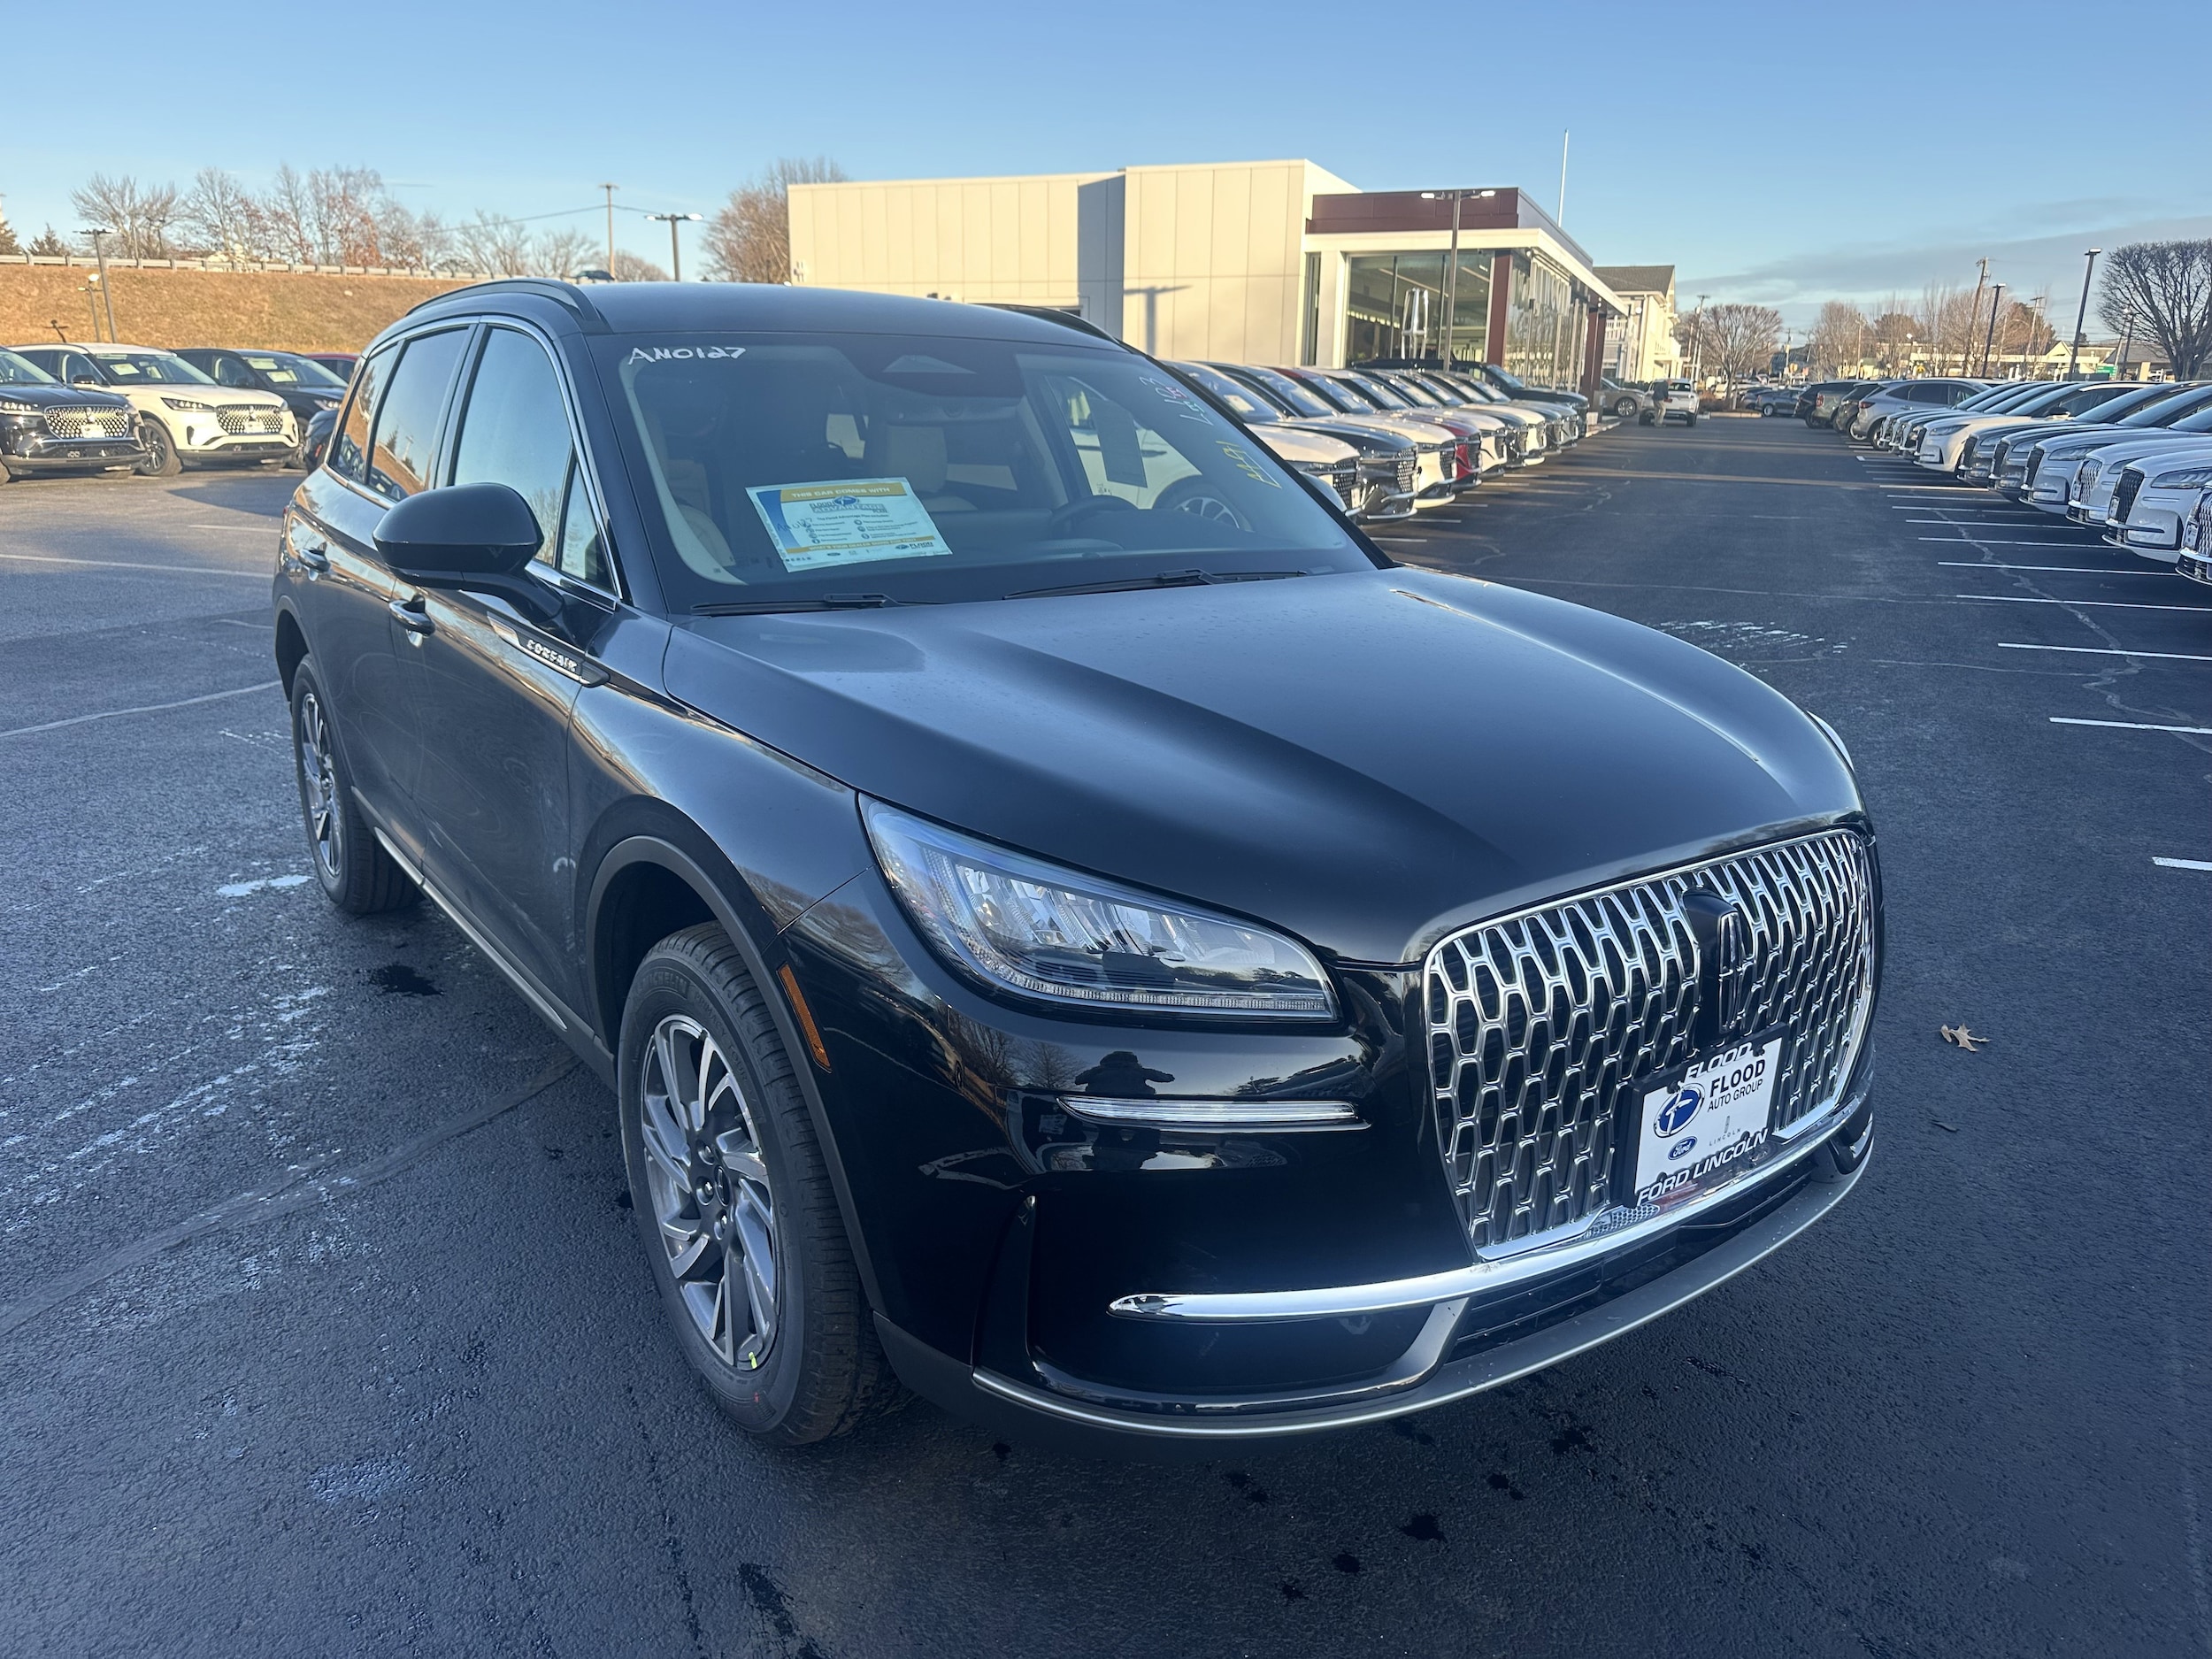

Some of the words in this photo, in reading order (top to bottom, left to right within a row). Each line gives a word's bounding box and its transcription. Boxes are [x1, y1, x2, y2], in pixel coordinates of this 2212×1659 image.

[813, 503, 885, 513] ADVANTAGE
[526, 639, 578, 672] CORSAIR
[1685, 1042, 1753, 1079] FLOOD
[1709, 1059, 1766, 1098] FLOOD
[1708, 1093, 1732, 1112] AUTO
[1733, 1079, 1763, 1101] GROUP
[1671, 1138, 1694, 1158] Ford
[1709, 1127, 1741, 1147] LINCOLN
[1637, 1169, 1690, 1207] FORD
[1693, 1128, 1769, 1179] LINCOLN
